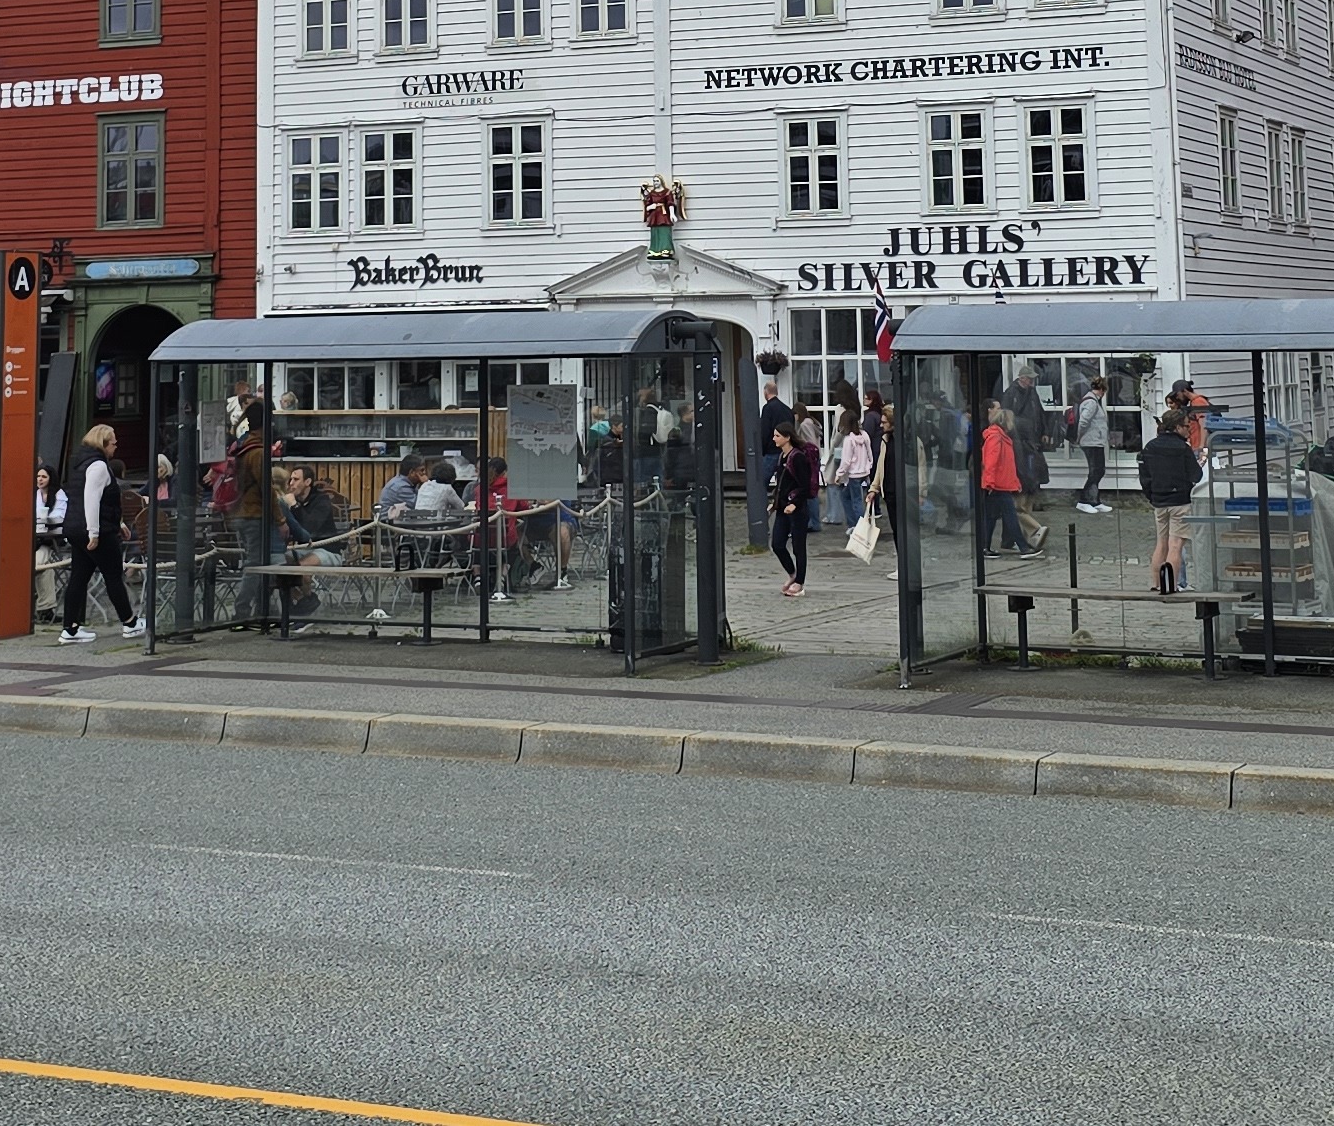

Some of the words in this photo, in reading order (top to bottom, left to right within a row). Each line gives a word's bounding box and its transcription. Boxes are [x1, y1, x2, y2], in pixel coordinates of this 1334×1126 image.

[704, 62, 843, 89] NETWORK
[850, 50, 1041, 81] CHARTERING
[1049, 47, 1110, 70] INT.
[401, 69, 524, 97] GARWARE
[403, 99, 456, 109] TECHNICAL
[460, 96, 494, 106] FIBRES
[14, 266, 30, 292] A
[797, 259, 939, 291] SILVER
[962, 254, 1150, 288] GALLERY
